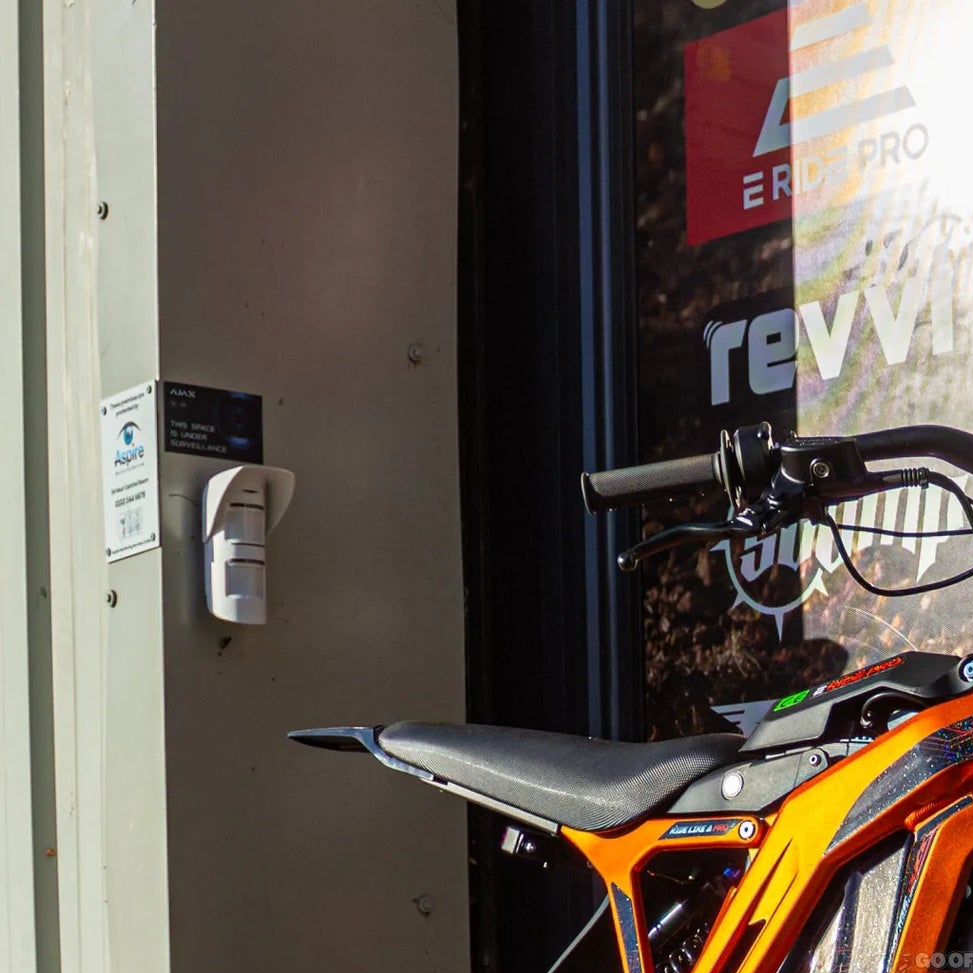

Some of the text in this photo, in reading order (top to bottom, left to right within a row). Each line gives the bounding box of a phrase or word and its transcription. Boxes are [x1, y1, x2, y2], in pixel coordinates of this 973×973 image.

[857, 122, 929, 171] PRO
[170, 420, 215, 433] THIS SPACE
[180, 432, 207, 441] UNDER
[170, 439, 227, 453] SURVEILLANCE
[114, 444, 145, 467] Aspire
